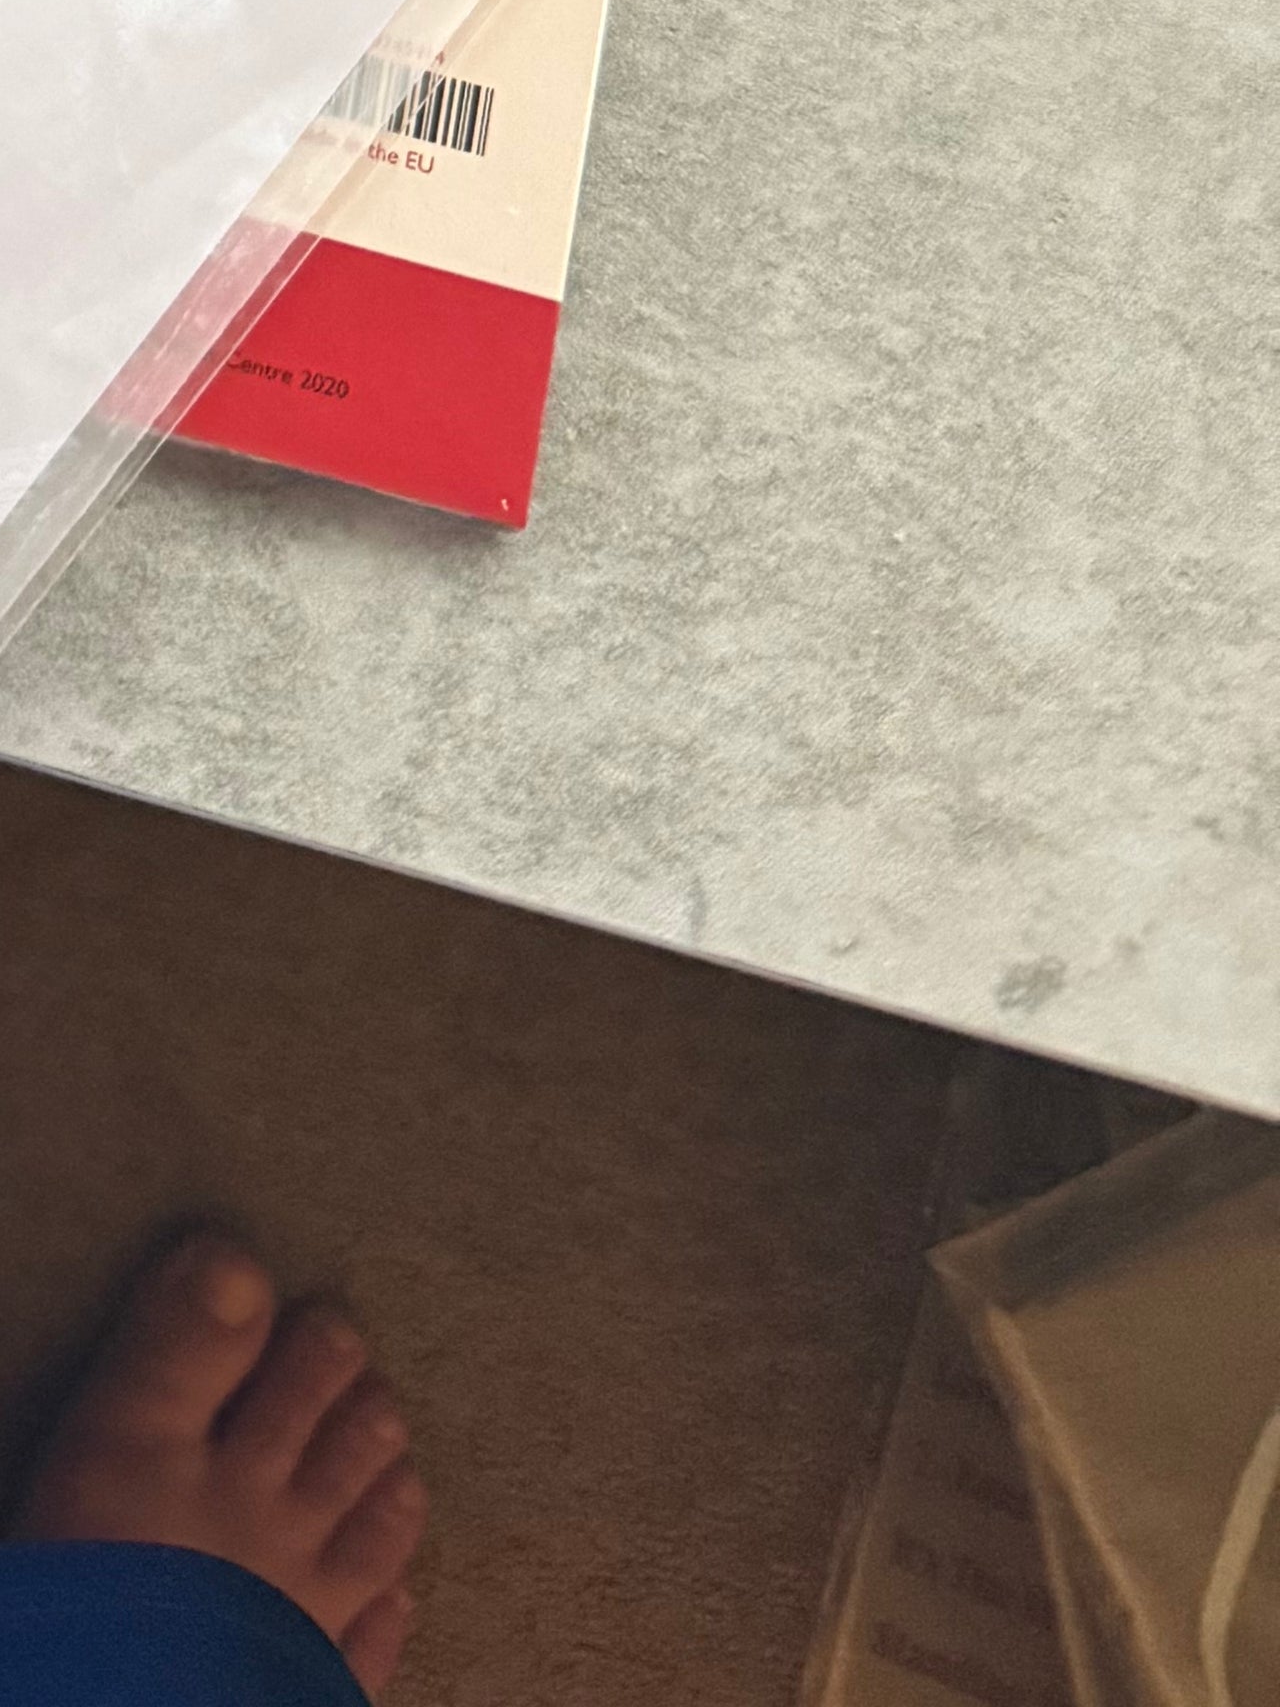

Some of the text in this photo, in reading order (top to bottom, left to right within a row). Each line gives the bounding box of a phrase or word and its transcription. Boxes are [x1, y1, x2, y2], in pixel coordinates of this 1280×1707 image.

[367, 142, 435, 174] the EU
[301, 370, 350, 399] 2020
